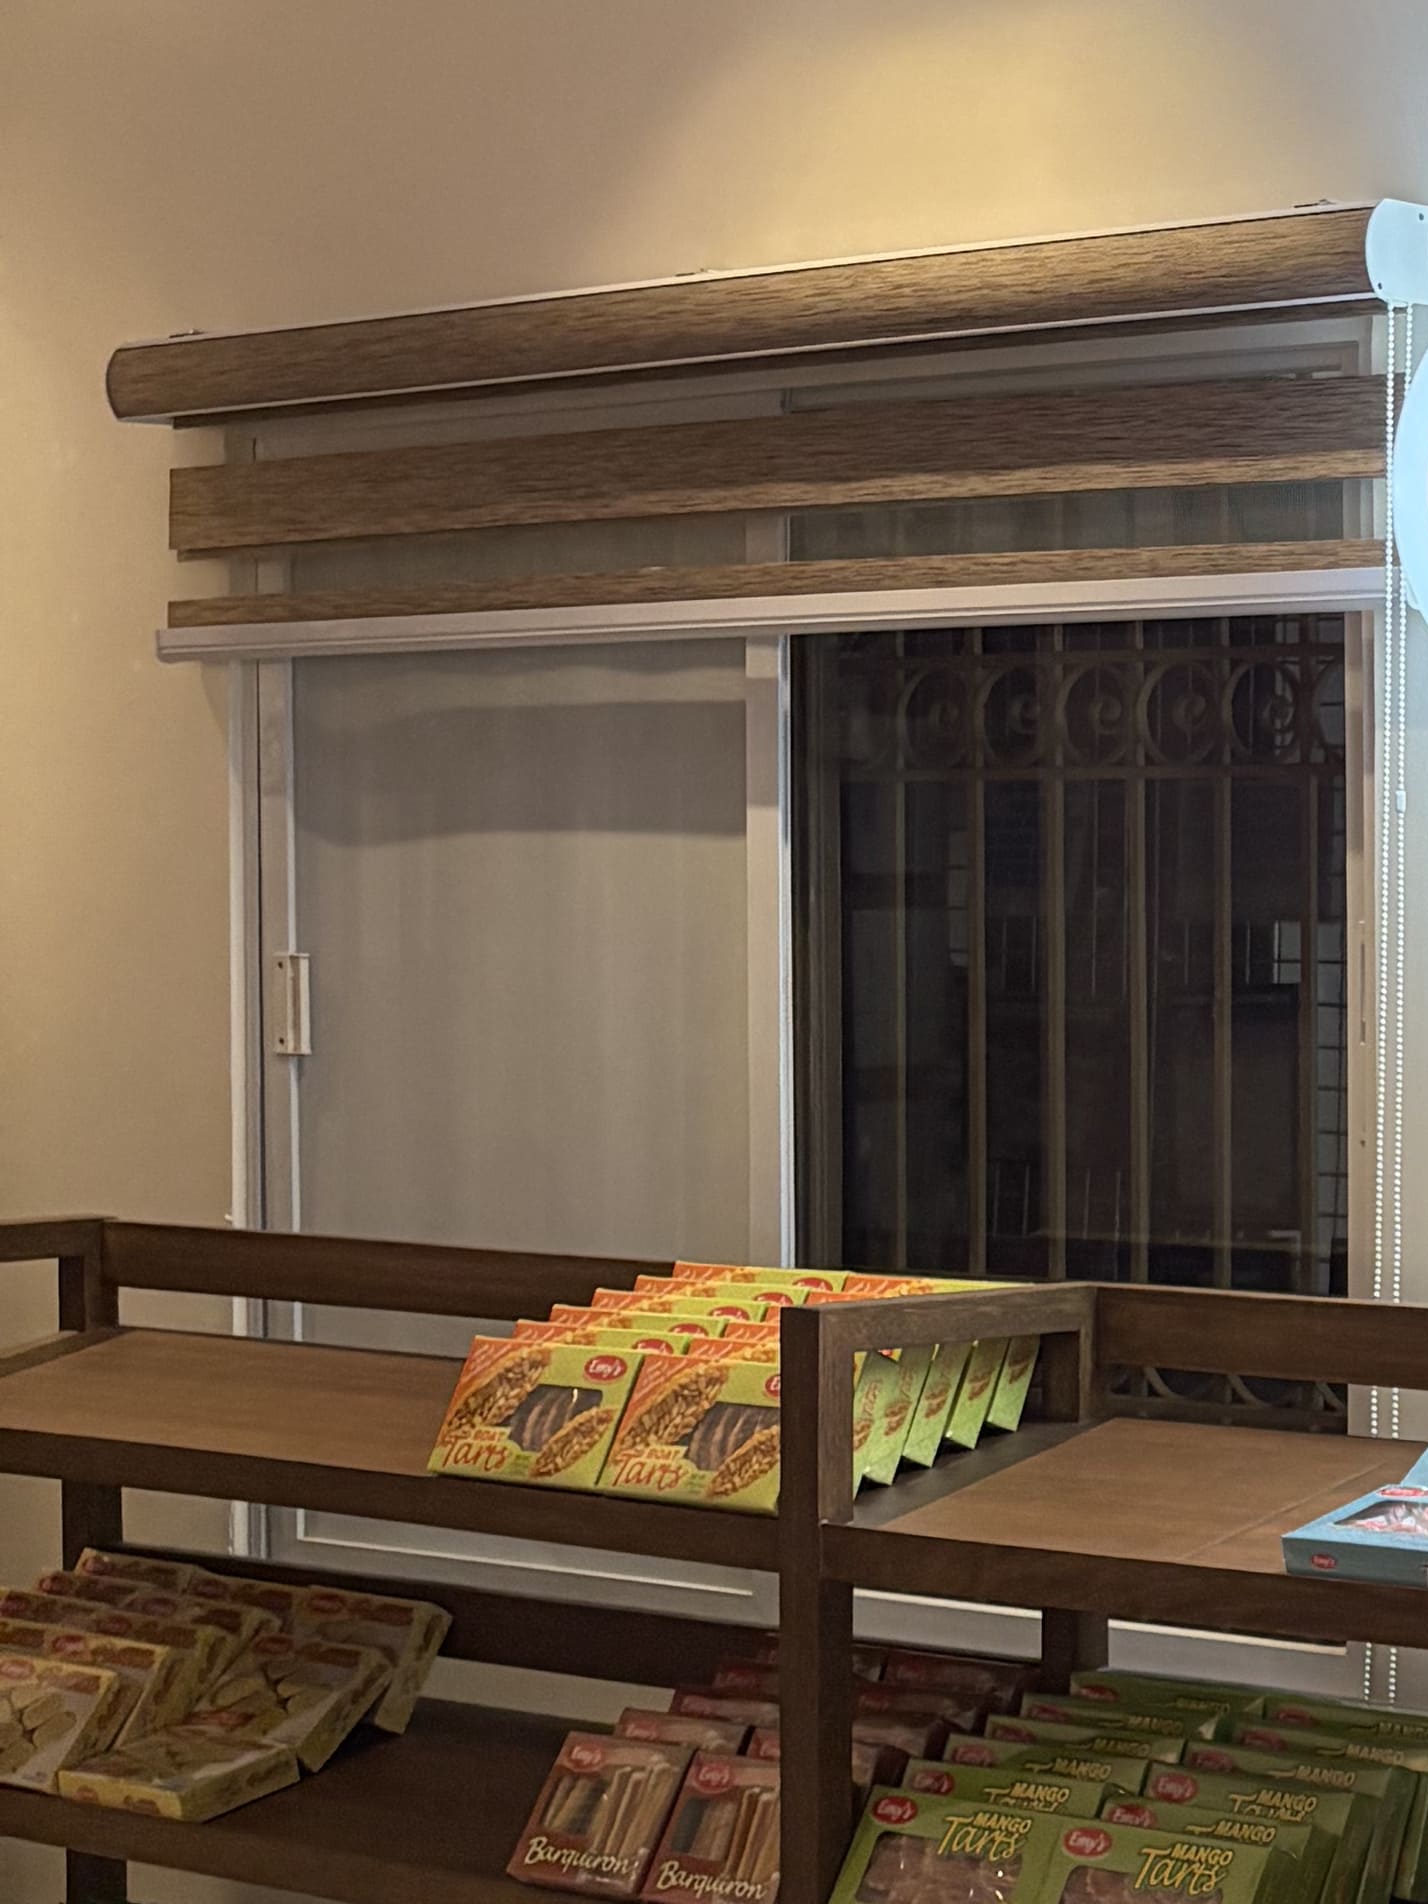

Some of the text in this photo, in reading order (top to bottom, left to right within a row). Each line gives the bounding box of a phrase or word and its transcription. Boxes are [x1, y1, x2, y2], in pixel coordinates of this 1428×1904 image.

[612, 1454, 685, 1491] Tarts
[1011, 1782, 1069, 1803] MANGO
[1257, 1789, 1318, 1812] MANGO
[973, 1811, 1032, 1833] MANGO
[1215, 1819, 1277, 1843] MANGO
[937, 1816, 1029, 1862] Tarts
[1172, 1844, 1234, 1866] MANGO
[1134, 1847, 1226, 1895] Tarts
